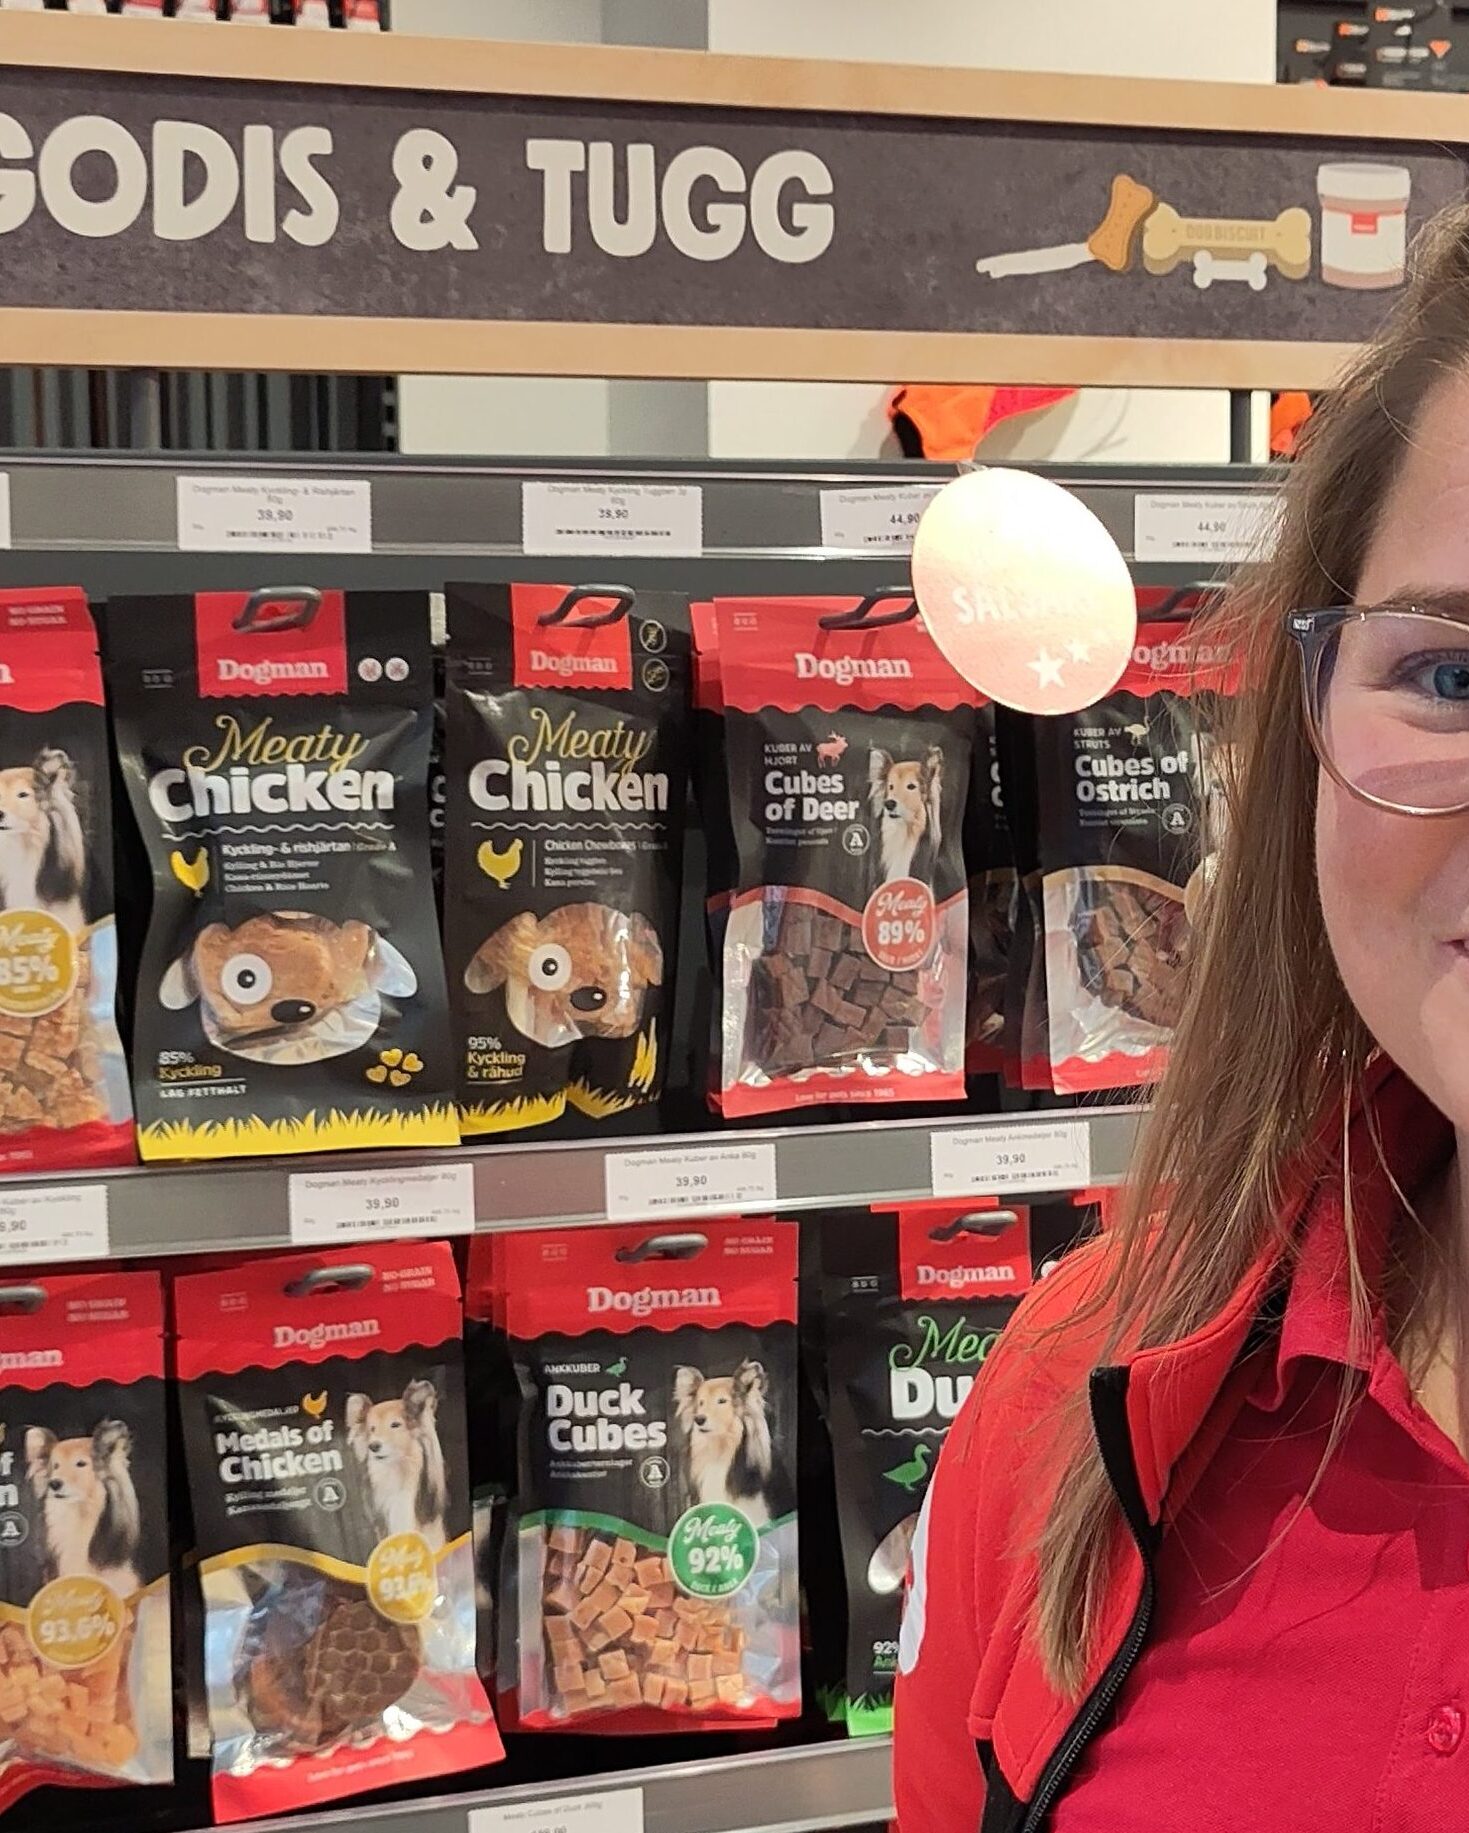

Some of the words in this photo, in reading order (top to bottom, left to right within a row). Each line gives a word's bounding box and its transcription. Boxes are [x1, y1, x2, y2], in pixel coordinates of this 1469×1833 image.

[390, 128, 479, 252] &
[526, 138, 836, 263] TUGG
[217, 658, 329, 685] Dogman
[530, 650, 618, 676] Dogman
[794, 652, 914, 686] Dogman
[184, 714, 371, 774] Meaty
[508, 707, 656, 777] Meaty
[764, 743, 797, 754] KUBER
[798, 743, 812, 753] AV
[1074, 739, 1111, 750] STRUTS
[764, 755, 798, 766] HJORT
[1075, 754, 1155, 778] Cubes
[1160, 750, 1189, 774] of
[148, 763, 396, 824] Chicken
[468, 758, 669, 812] Chicken
[765, 770, 845, 796] Cubes
[1076, 777, 1171, 803] Ostrich
[765, 799, 796, 821] of
[803, 796, 860, 822] Deer
[280, 841, 292, 854] &
[544, 839, 583, 852] Chicken
[877, 921, 926, 945] 89%
[468, 1036, 502, 1051] 95%
[158, 1050, 196, 1065] 85%
[467, 1051, 526, 1066] Kyckling
[159, 1065, 222, 1080] Kyckling
[467, 1066, 478, 1079] &
[952, 1137, 983, 1146] Dogman
[996, 1153, 1026, 1165] 39,90
[675, 1175, 708, 1187] 39,90
[365, 1196, 400, 1210] 39,90
[916, 1265, 1016, 1288] Dogman
[587, 1285, 722, 1316] Dogman
[273, 1316, 381, 1350] Dogman
[547, 1383, 646, 1418] Duck
[215, 1425, 304, 1455] Medals
[306, 1419, 334, 1445] of
[549, 1418, 667, 1451] Cubes
[219, 1449, 344, 1484] Chicken
[682, 1515, 742, 1545] Meaty
[687, 1544, 745, 1575] 92%
